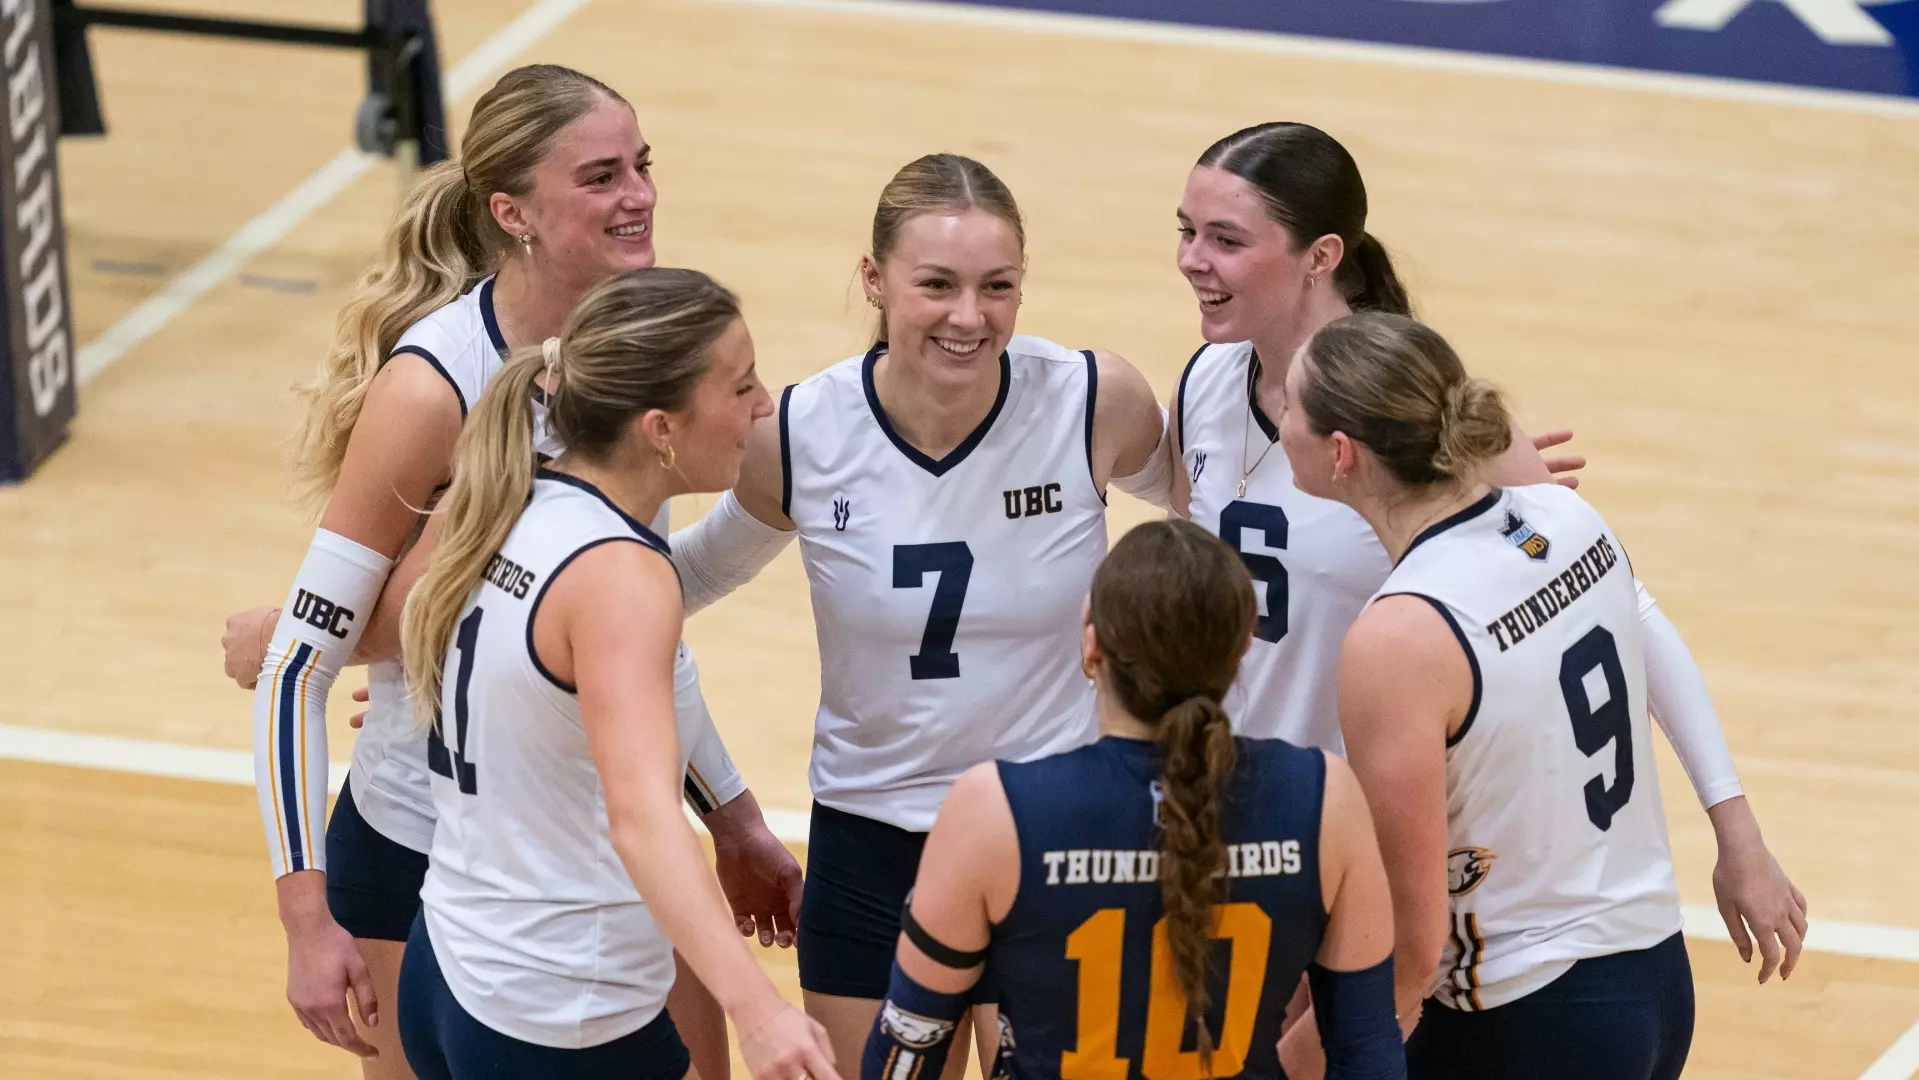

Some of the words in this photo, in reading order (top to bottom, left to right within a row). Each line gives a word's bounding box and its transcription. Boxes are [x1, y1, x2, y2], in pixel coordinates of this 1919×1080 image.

[1003, 481, 1064, 521] UBC
[291, 588, 355, 640] UBC
[892, 540, 975, 680] 7
[1219, 500, 1289, 644] 6
[1486, 532, 1618, 653] THUNDERBIRDS
[1558, 624, 1635, 833] 9
[1043, 840, 1301, 885] THUNDIRDS
[1060, 902, 1273, 1080] 10
